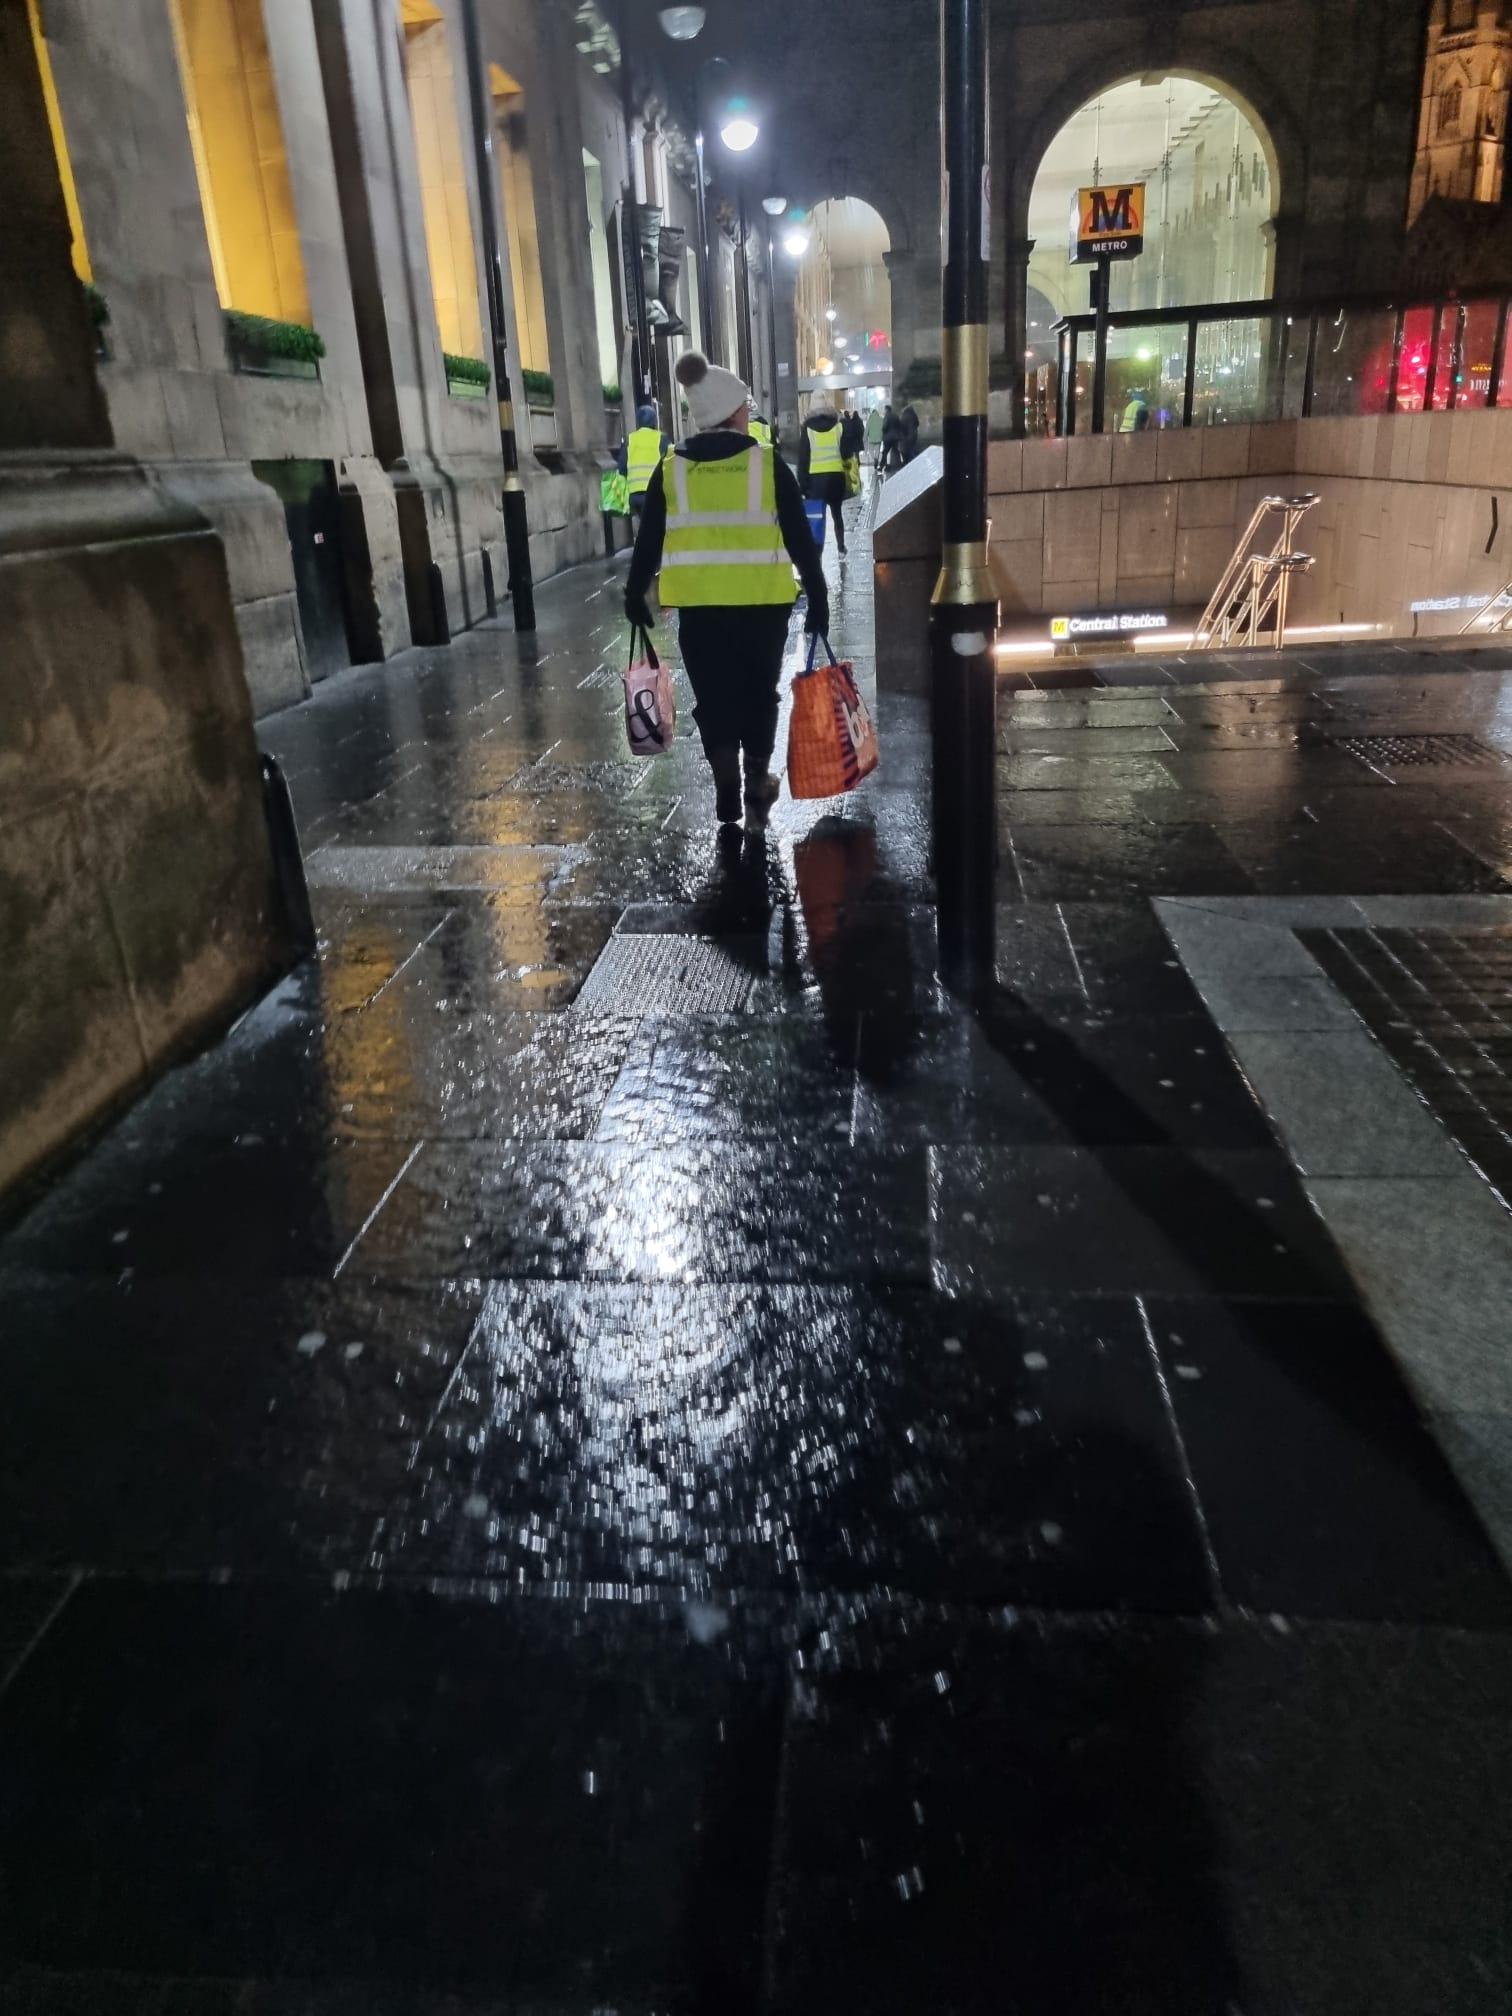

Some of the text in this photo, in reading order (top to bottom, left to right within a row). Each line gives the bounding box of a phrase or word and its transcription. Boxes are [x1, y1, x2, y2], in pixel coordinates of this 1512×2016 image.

[1089, 188, 1133, 233] M
[1092, 240, 1128, 253] METRO
[1069, 614, 1118, 632] Central
[1120, 613, 1168, 630] Station
